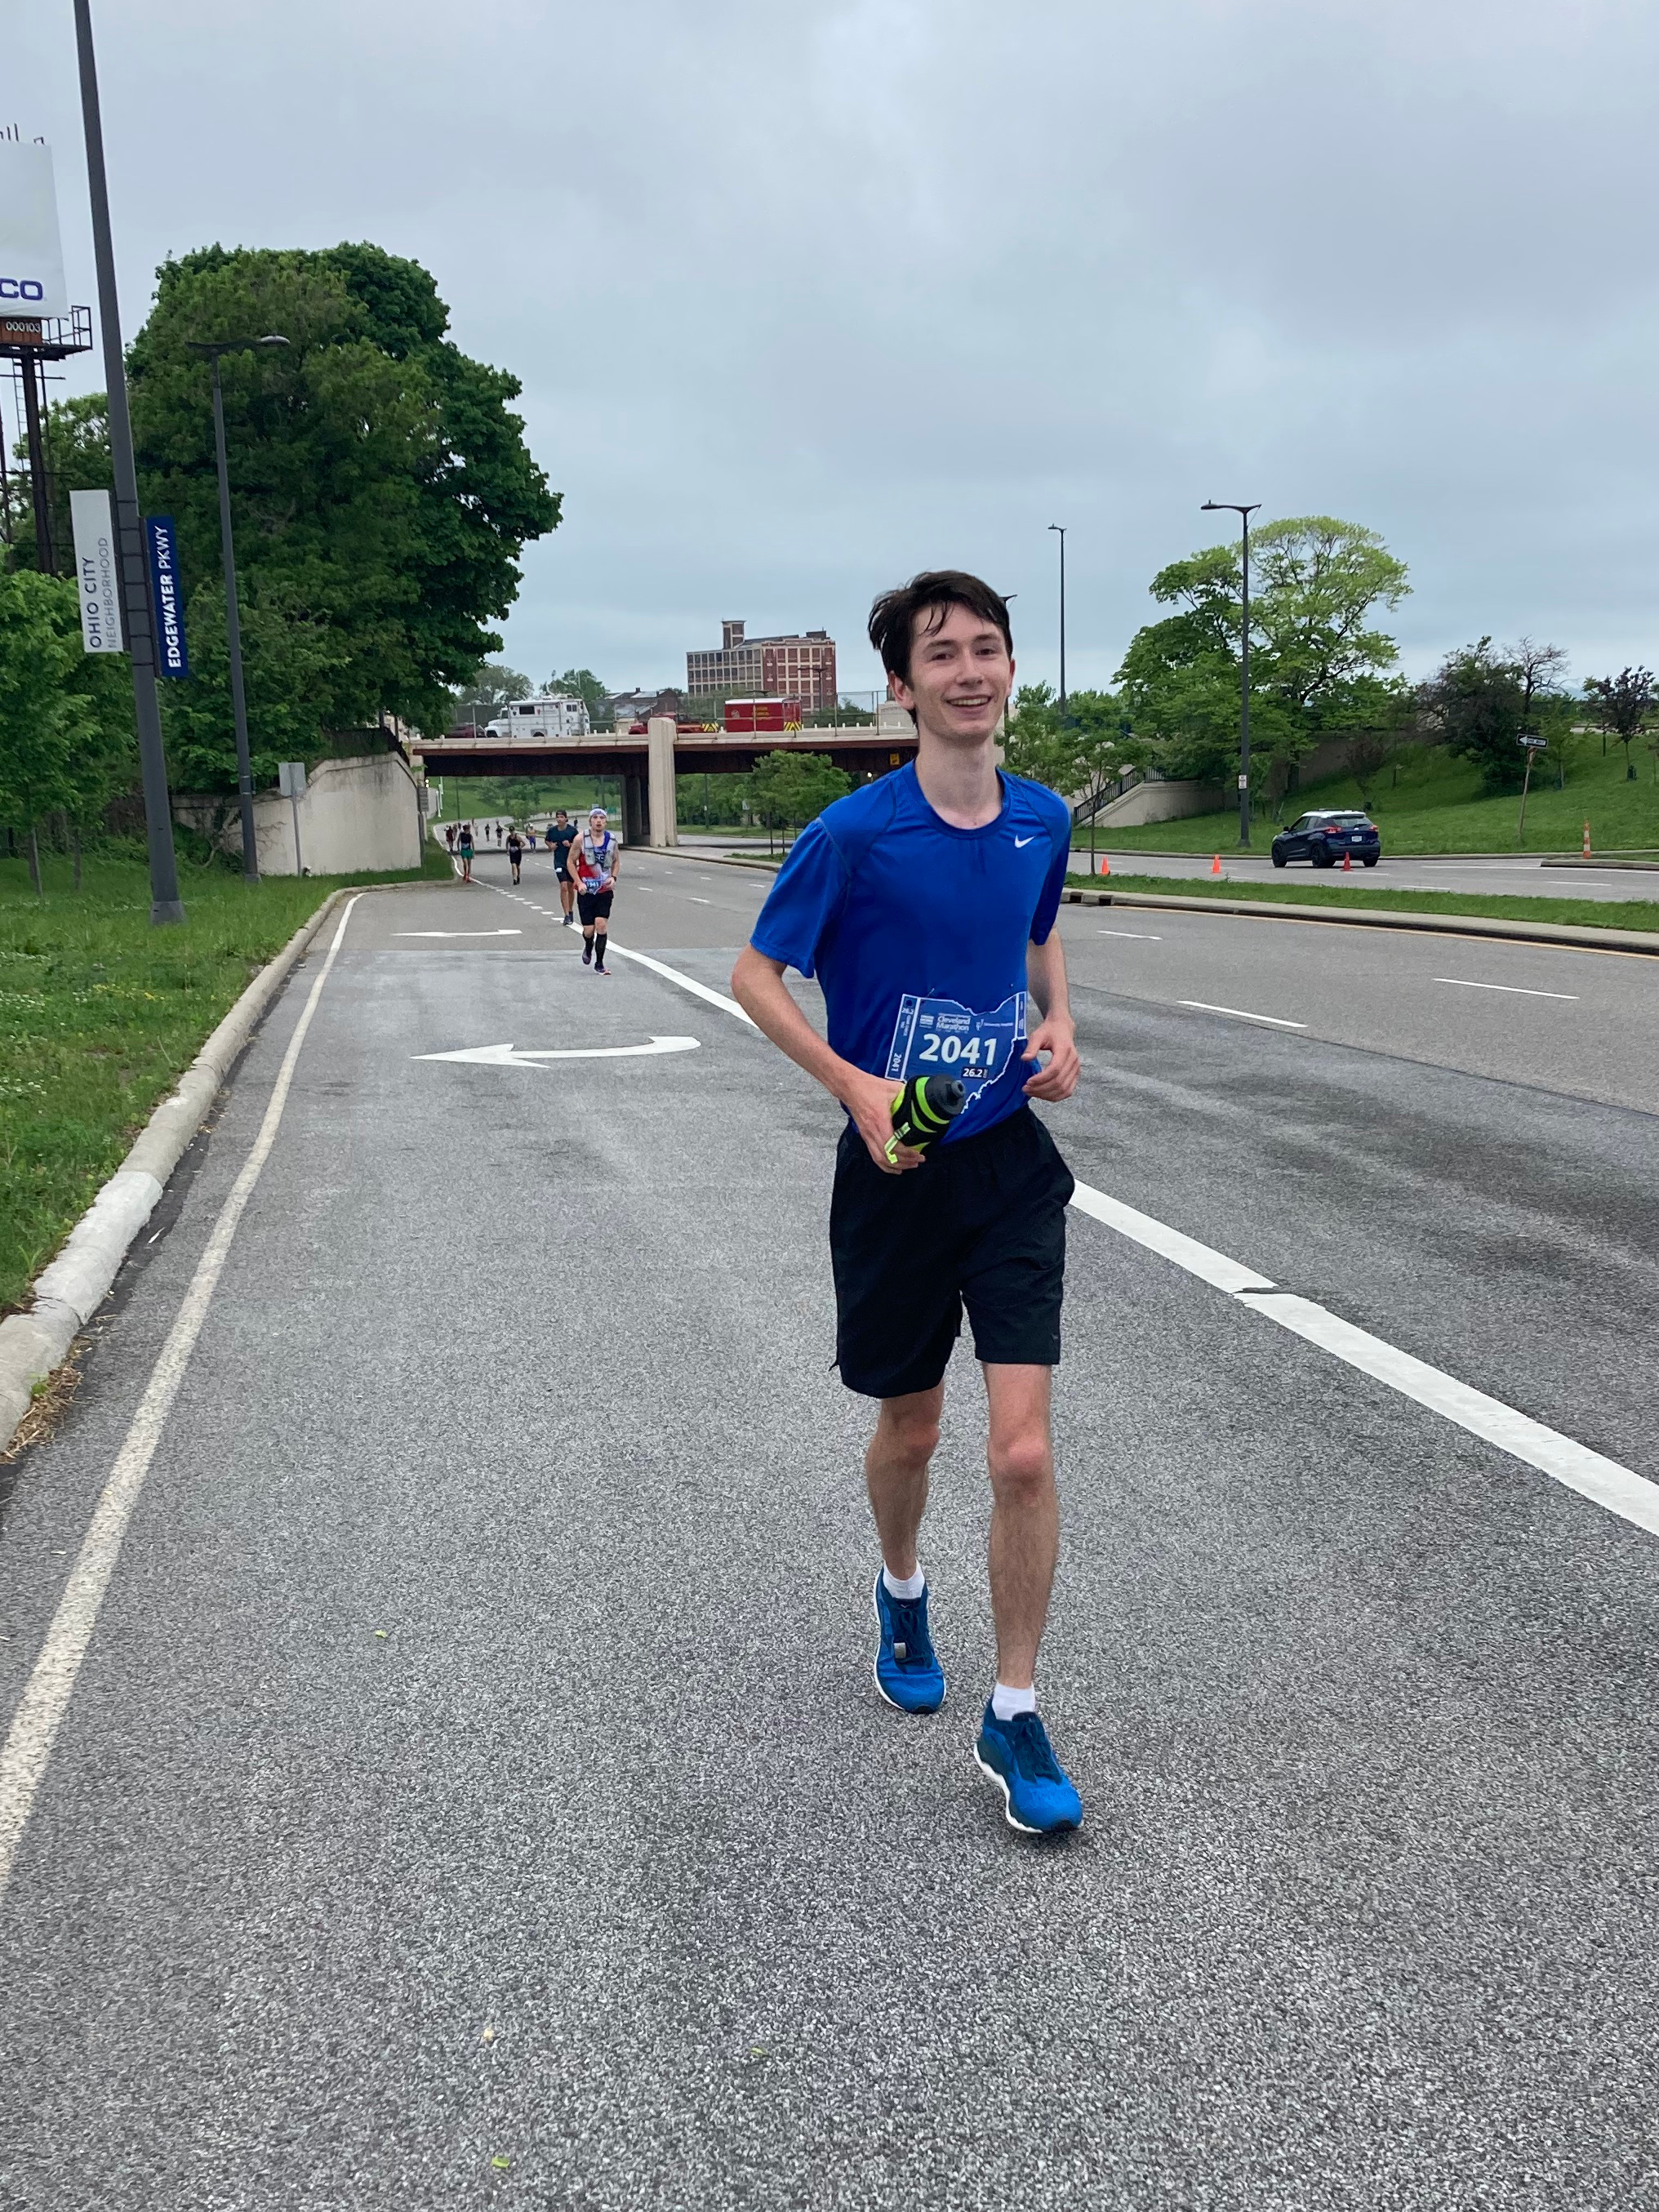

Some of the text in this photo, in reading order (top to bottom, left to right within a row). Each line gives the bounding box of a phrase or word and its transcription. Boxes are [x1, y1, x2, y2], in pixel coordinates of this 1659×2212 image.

[6, 321, 41, 332] 000103
[98, 536, 117, 649] NEIGHBORHOOD
[153, 525, 182, 668] EDGEWATER PKWY
[82, 557, 102, 649] OHIO CITY
[936, 1021, 970, 1031] Marathon
[937, 1016, 971, 1025] Cleveland
[918, 1033, 997, 1066] 2041
[891, 1053, 902, 1072] 2041
[962, 1067, 983, 1078] 26.2
